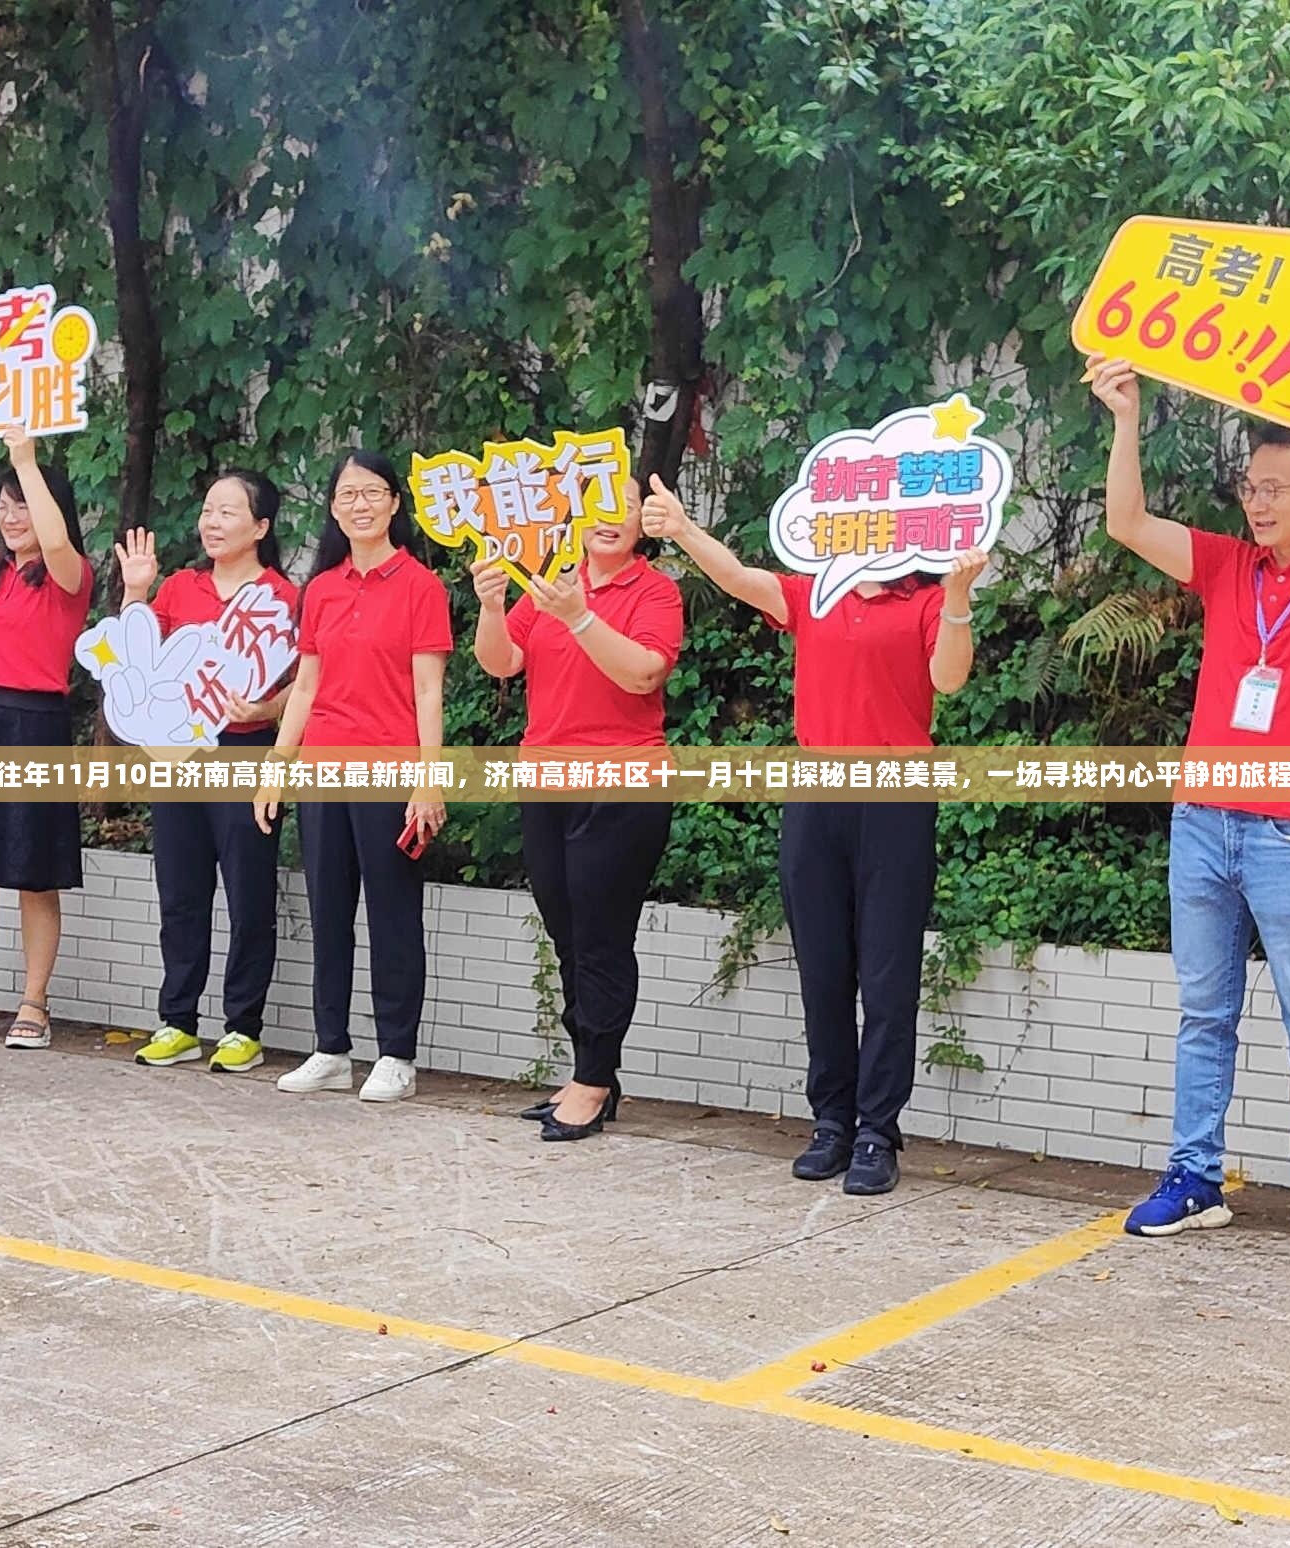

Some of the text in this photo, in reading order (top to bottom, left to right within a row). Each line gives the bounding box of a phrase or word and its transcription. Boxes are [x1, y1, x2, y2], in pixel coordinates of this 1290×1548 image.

[1155, 233, 1285, 305] 高考!
[420, 441, 619, 537] 我能行
[811, 449, 984, 503] 执守梦想
[483, 523, 574, 563] DO IT!
[810, 503, 984, 557] 相伴同行
[184, 590, 298, 727] 优秀
